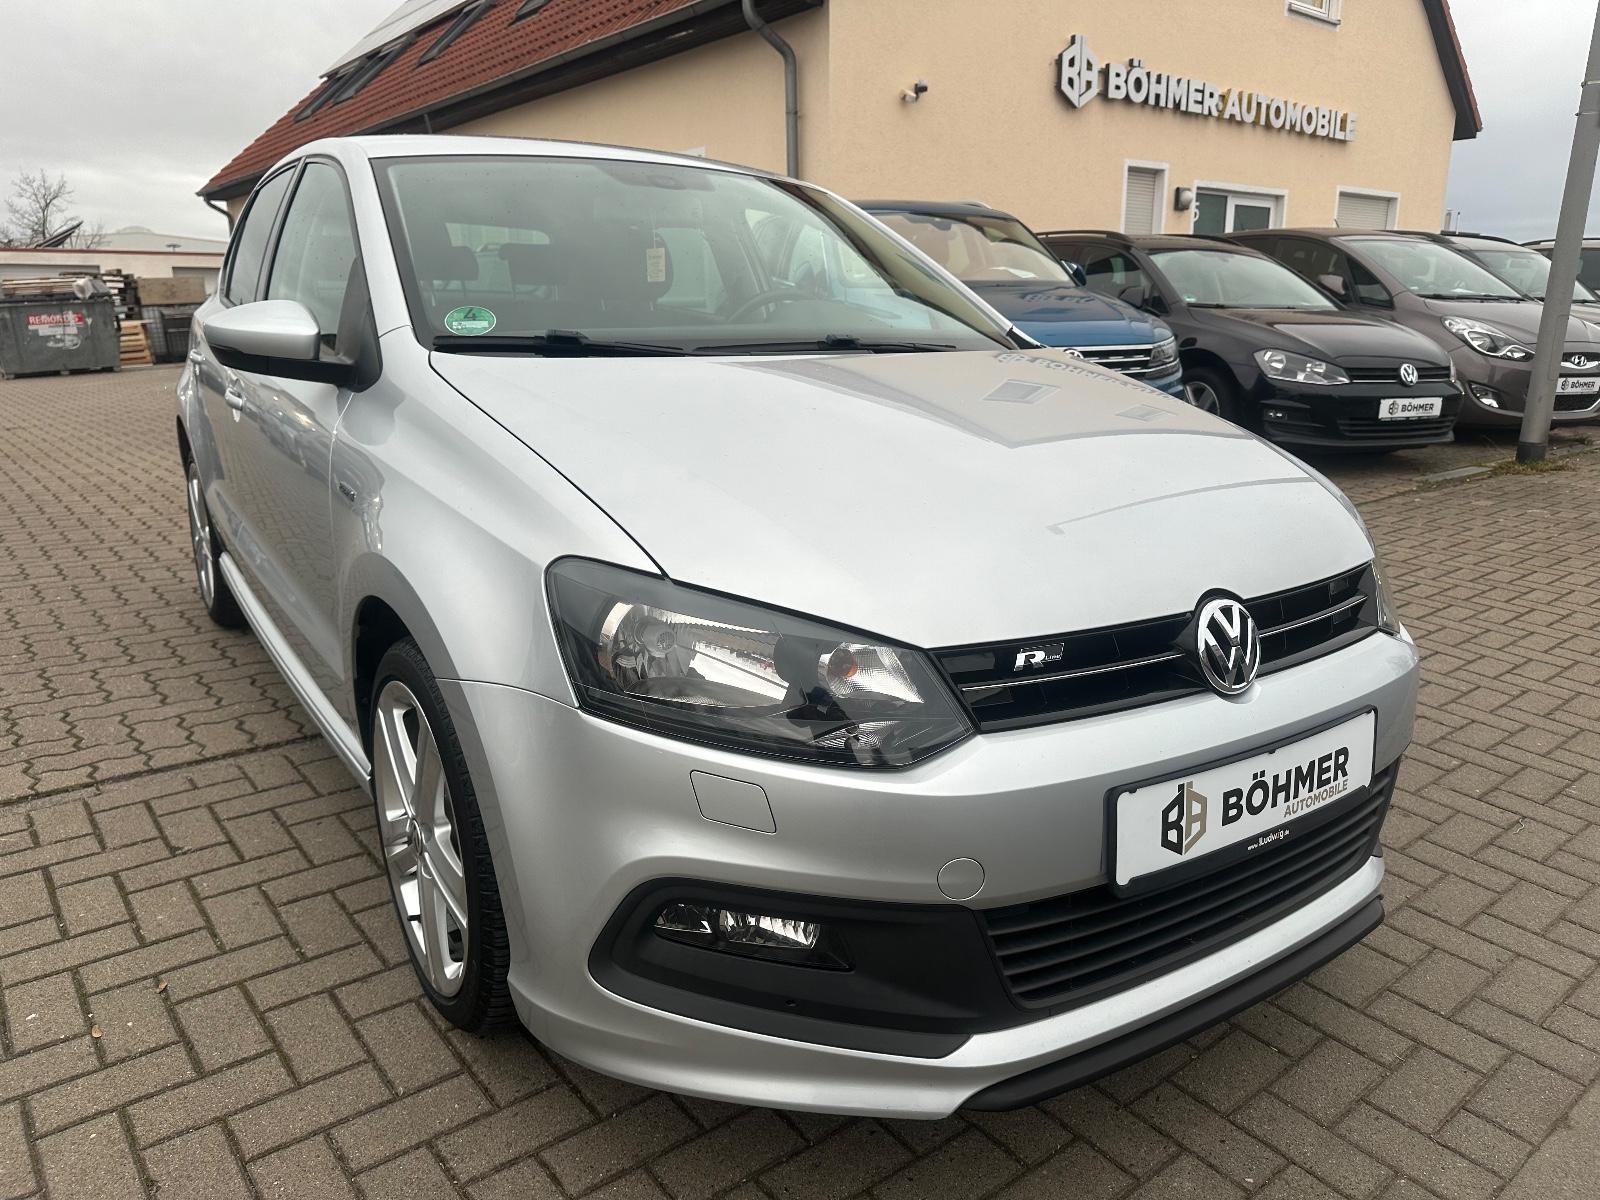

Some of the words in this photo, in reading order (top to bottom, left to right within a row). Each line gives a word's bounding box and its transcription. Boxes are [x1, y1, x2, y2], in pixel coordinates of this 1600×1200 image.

[1104, 57, 1219, 117] BÖHMER
[1223, 86, 1358, 141] AUTOMOBILE
[464, 308, 477, 320] 4
[1400, 401, 1435, 413] BÖHMER
[1221, 746, 1349, 827] BÖHMER
[1283, 778, 1348, 818] AUTOMOBILE
